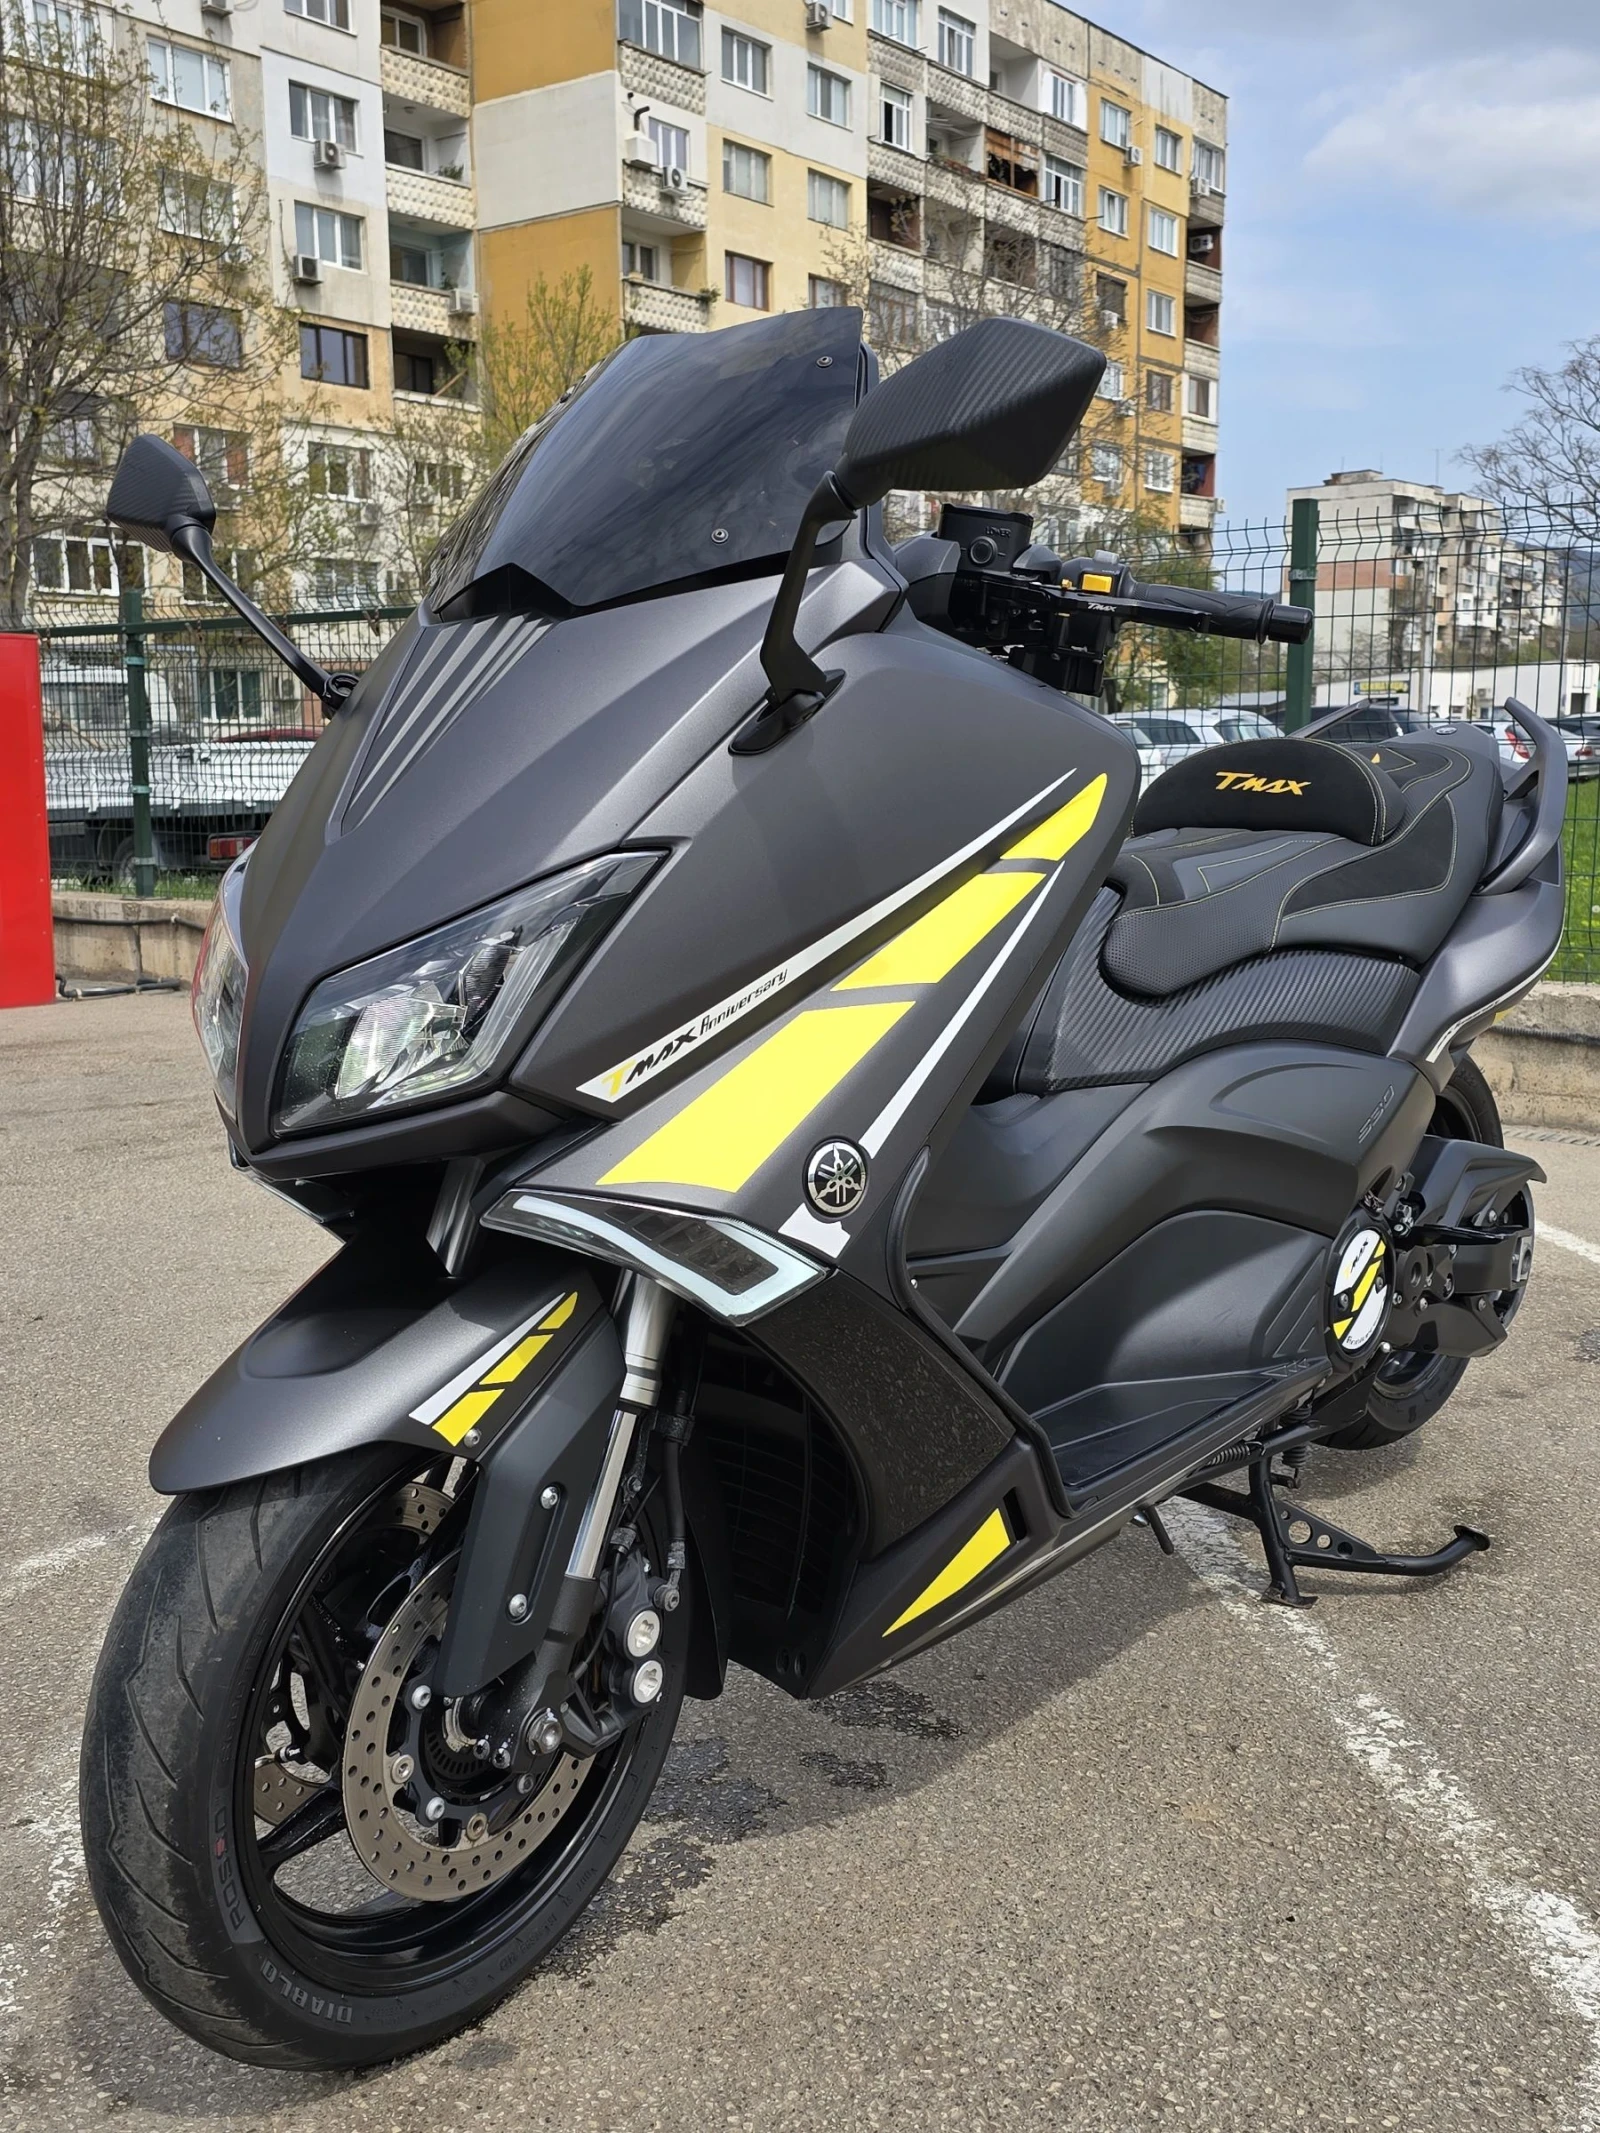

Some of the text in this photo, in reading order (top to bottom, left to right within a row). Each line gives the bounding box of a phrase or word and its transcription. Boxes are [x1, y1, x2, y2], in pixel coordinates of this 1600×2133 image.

[985, 526, 1012, 538] LOWER
[1215, 771, 1312, 796] TMAX
[601, 968, 788, 1097] TMAX Anniversary
[214, 1805, 246, 1931] ROSSO
[260, 1959, 353, 2024] DIABLO
